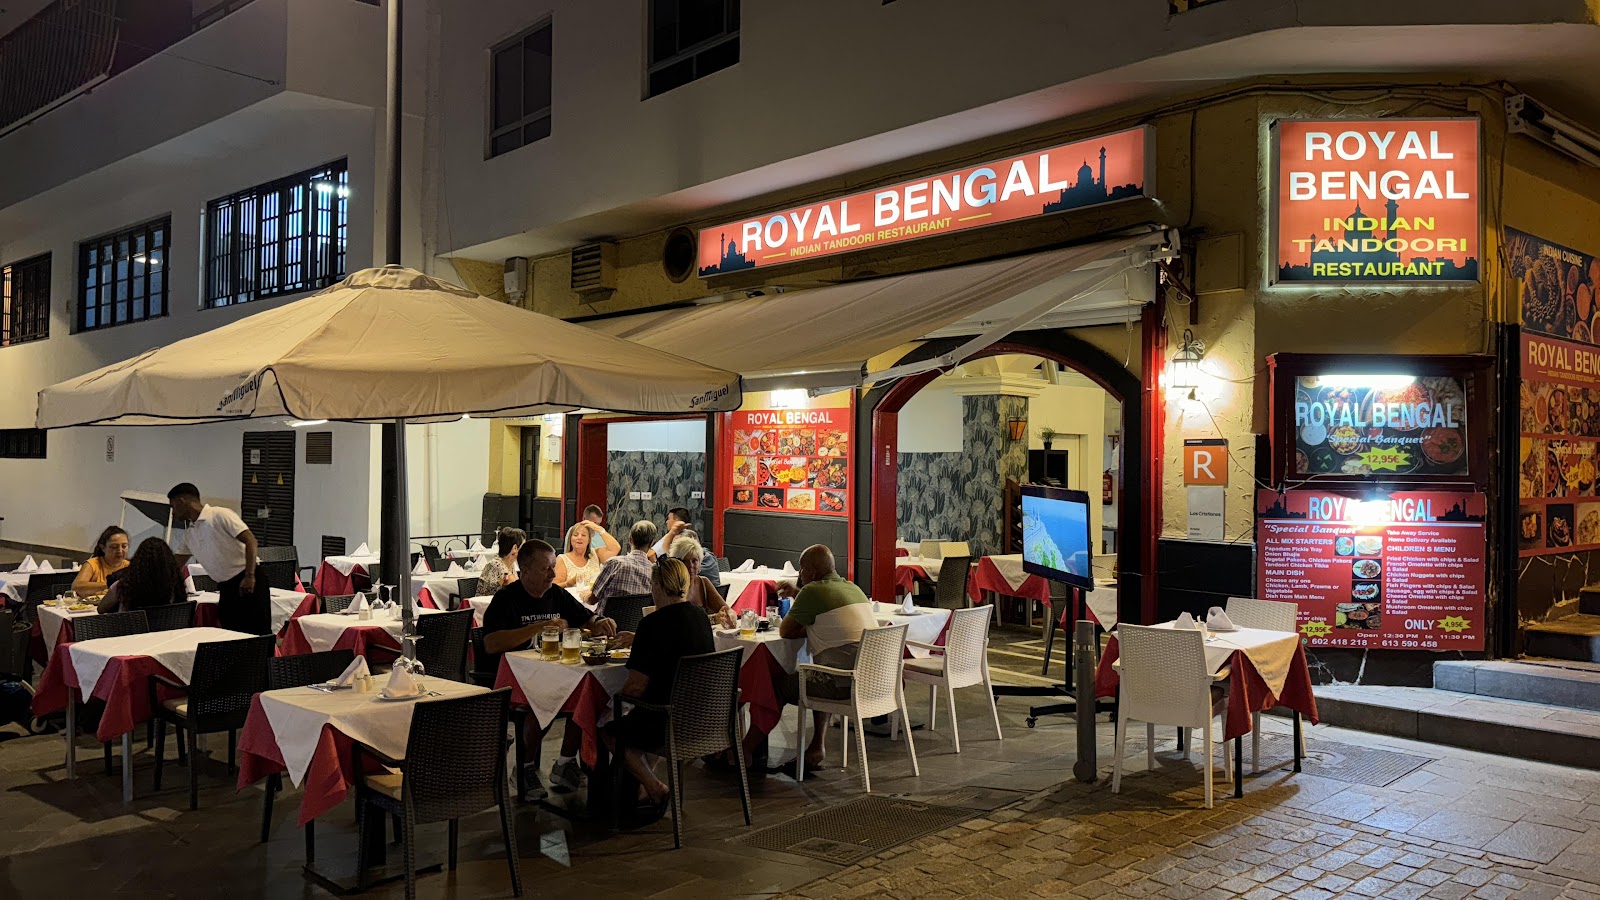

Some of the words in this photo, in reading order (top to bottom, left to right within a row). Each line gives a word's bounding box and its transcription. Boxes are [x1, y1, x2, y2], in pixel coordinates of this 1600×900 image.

[1305, 131, 1454, 160] ROYAL
[1289, 170, 1470, 200] BENGAL
[741, 200, 861, 254] ROYAL
[873, 153, 1068, 228] BENGAL
[1323, 217, 1435, 231] INDIAN
[790, 242, 821, 257] INDIAN
[822, 232, 875, 252] TANDOORI
[877, 217, 952, 242] RESTAURANT
[1292, 238, 1467, 253] TANDOORI
[1313, 262, 1445, 277] RESTAURANT
[1562, 251, 1583, 267] CUISINE
[1529, 340, 1572, 371] ROYAL
[747, 412, 784, 425] ROYAL
[786, 411, 833, 424] BENGAL
[1296, 402, 1367, 427] ROYAL
[1372, 402, 1459, 428] BENGAL
[1193, 450, 1216, 479] R
[1366, 455, 1400, 465] 12,95€
[1404, 619, 1435, 630] ONLY
